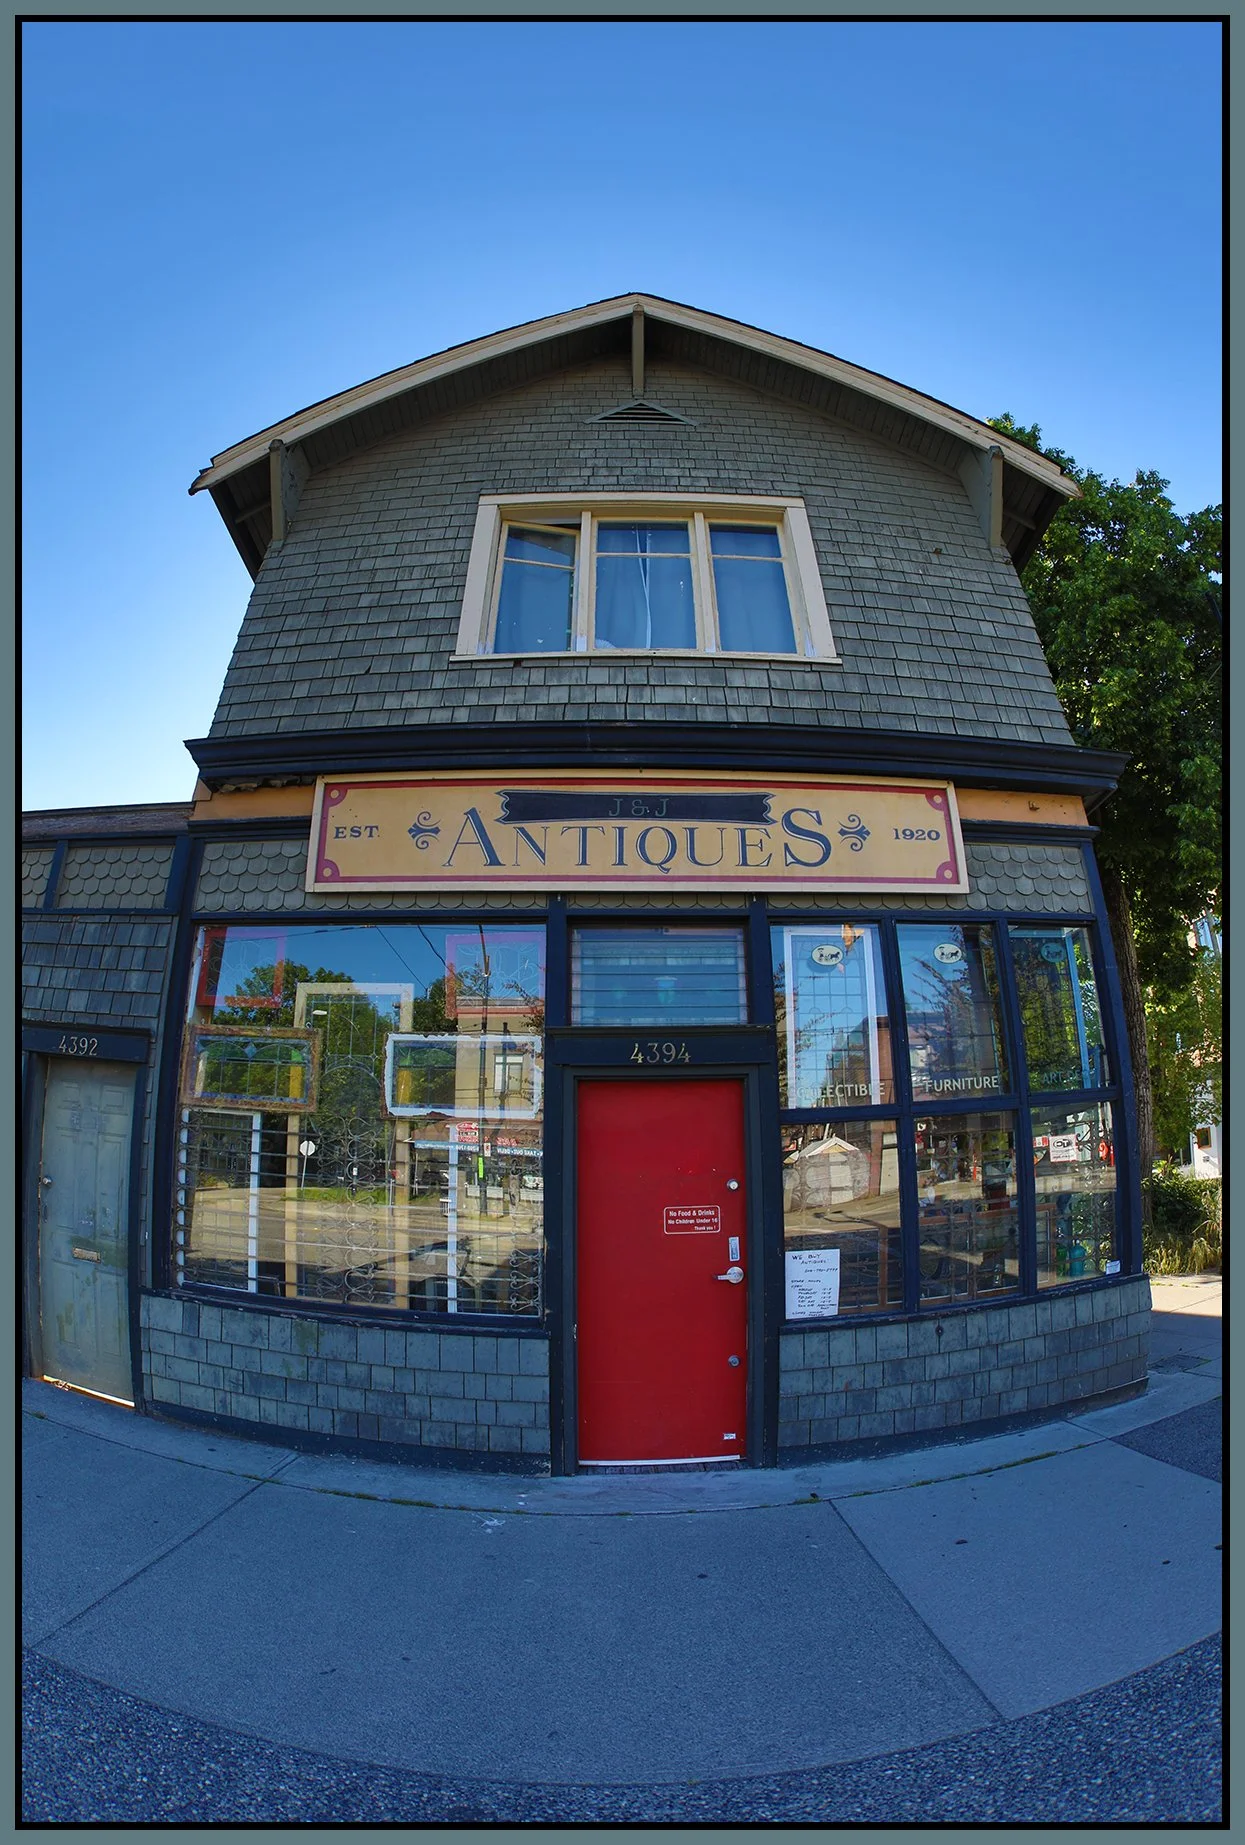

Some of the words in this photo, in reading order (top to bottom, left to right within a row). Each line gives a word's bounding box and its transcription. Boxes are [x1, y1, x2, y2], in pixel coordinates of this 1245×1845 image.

[441, 806, 832, 874] ANTIQUES
[892, 827, 941, 842] 1920
[58, 1035, 99, 1056] 4392
[629, 1042, 692, 1064] 4394
[923, 1075, 999, 1093] FURNITURE
